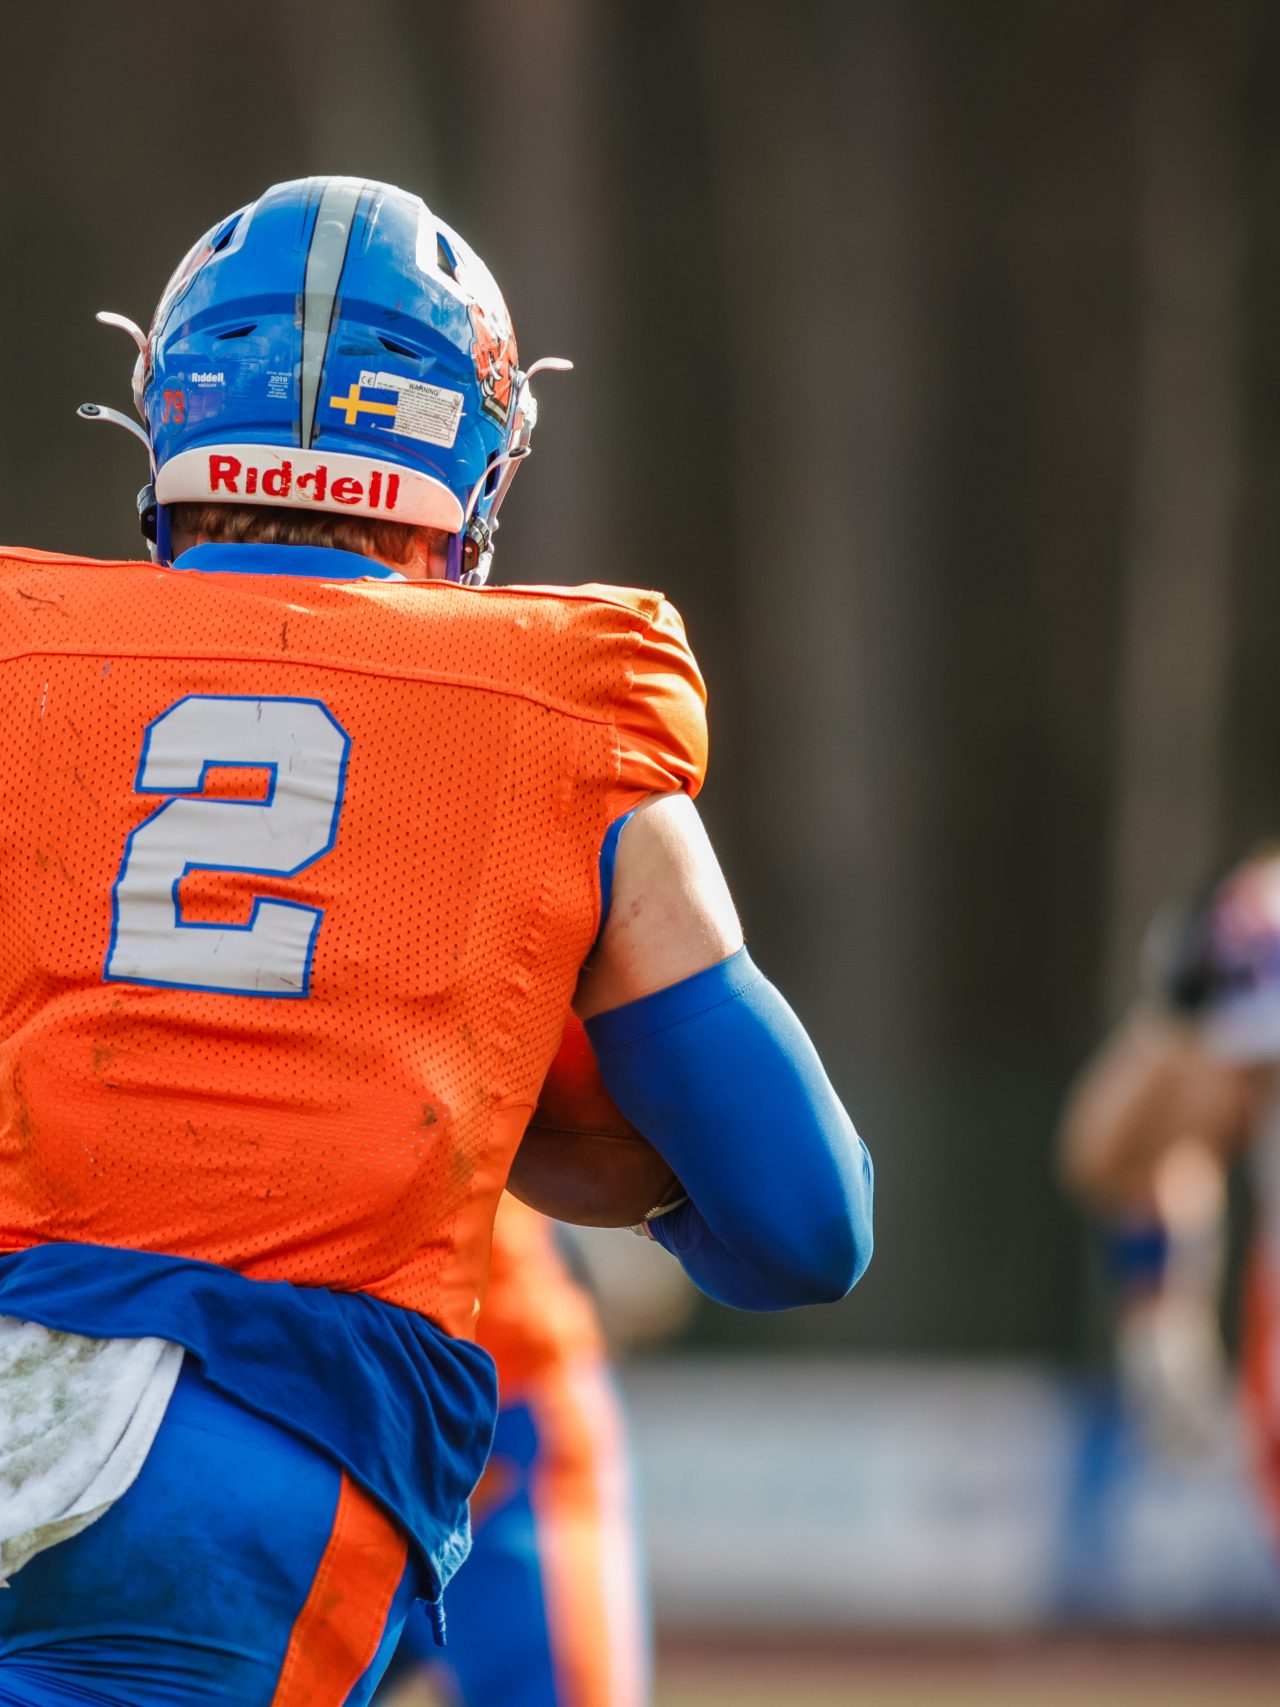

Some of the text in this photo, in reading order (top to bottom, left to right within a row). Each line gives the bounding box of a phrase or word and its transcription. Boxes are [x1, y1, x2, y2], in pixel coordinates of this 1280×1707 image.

[191, 372, 224, 382] Riddell
[270, 375, 288, 383] 2019
[408, 383, 439, 396] WARNING
[163, 389, 184, 424] 79
[208, 454, 400, 510] Riddell
[103, 694, 352, 998] 2
